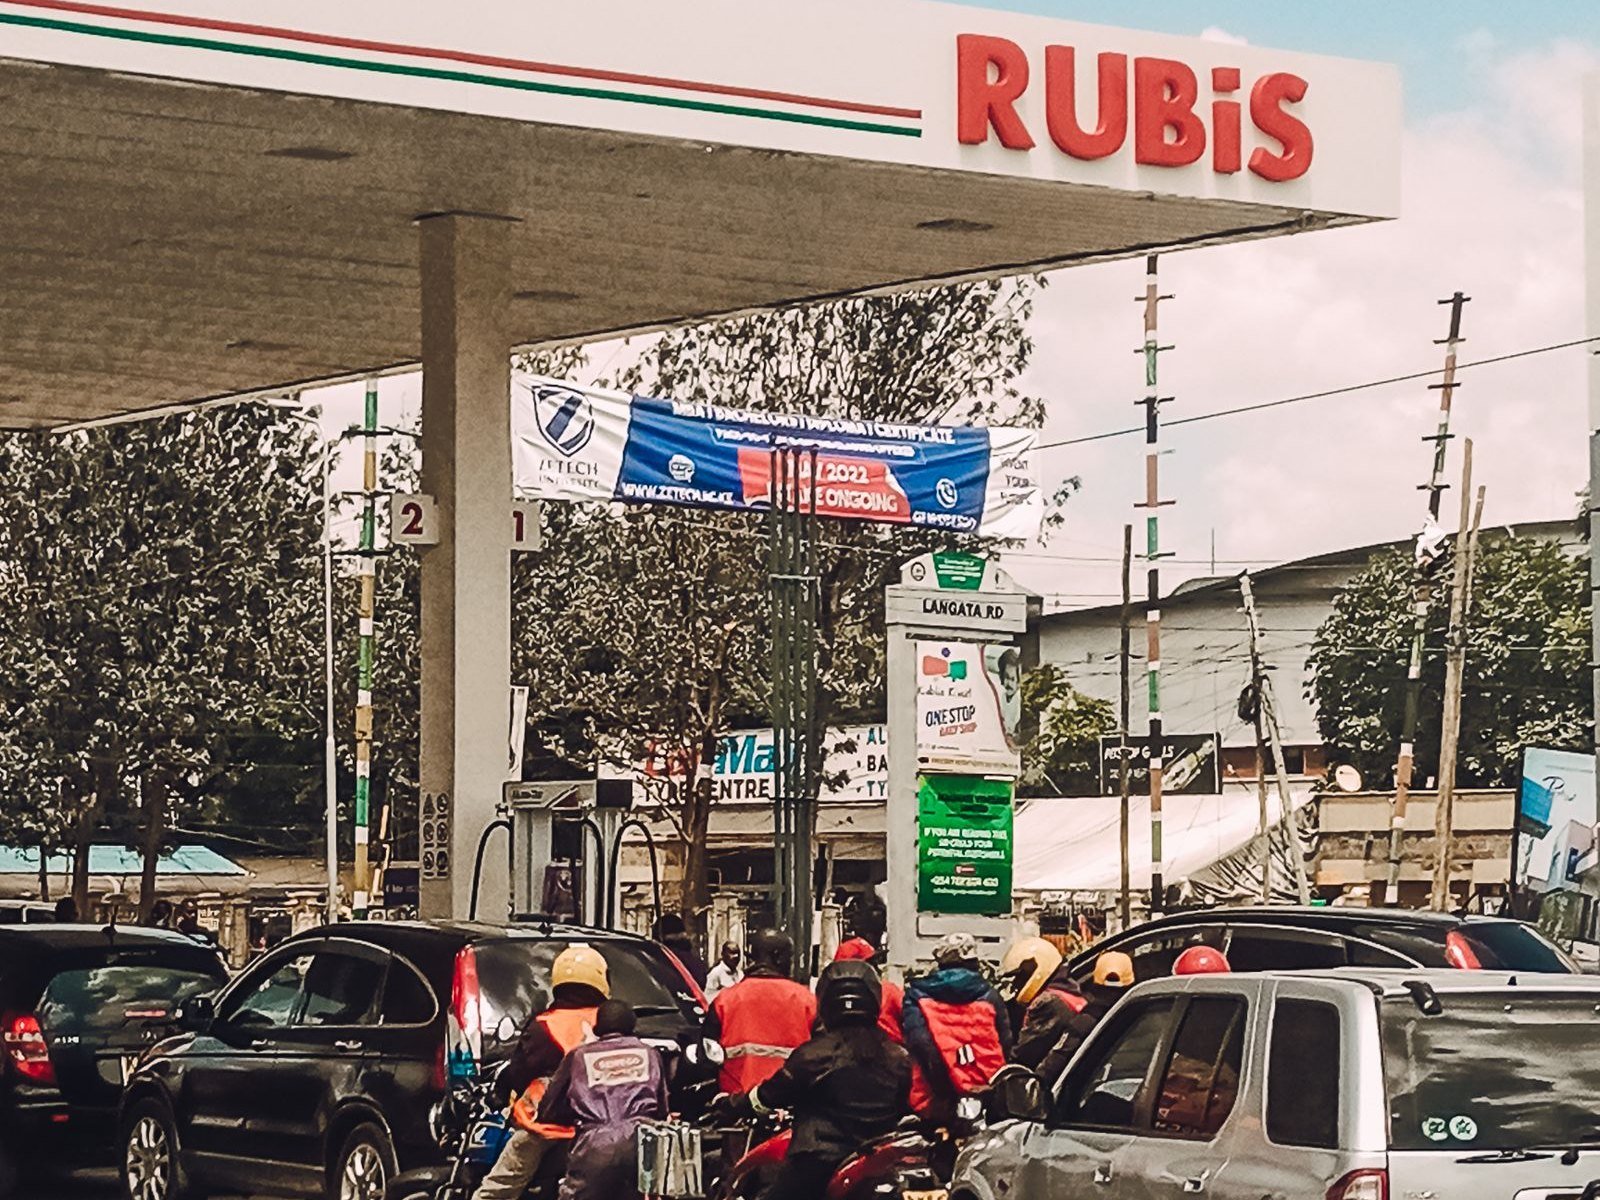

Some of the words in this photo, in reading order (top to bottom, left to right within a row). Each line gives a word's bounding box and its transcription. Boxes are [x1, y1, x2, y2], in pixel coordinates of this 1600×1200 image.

[957, 33, 1313, 182] RUBiS
[826, 463, 870, 484] 2022
[826, 488, 898, 512] ONGOING
[401, 502, 423, 534] 2
[513, 511, 524, 542] 1
[922, 598, 983, 618] LANGATA
[985, 605, 1004, 619] RD
[926, 709, 948, 727] ONE
[949, 705, 976, 723] STOP
[699, 779, 769, 800] ENTRE
